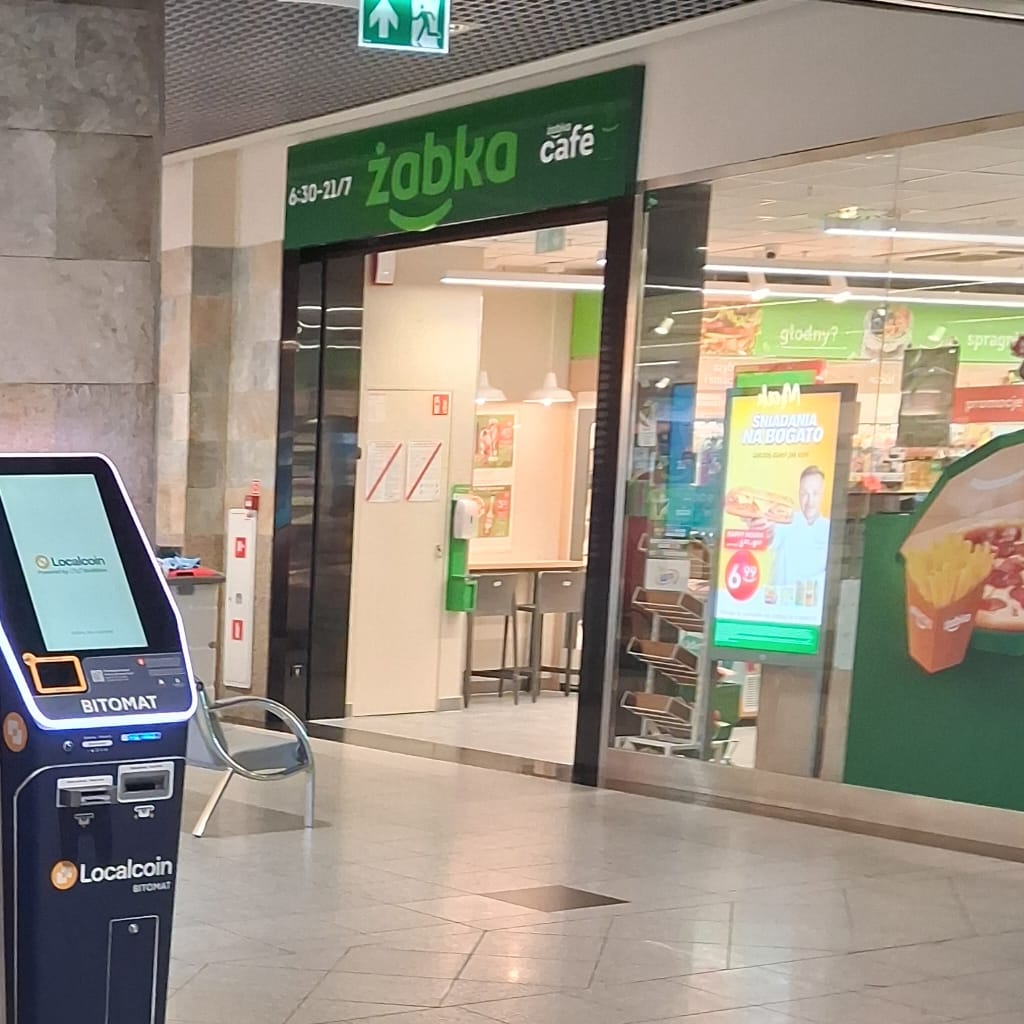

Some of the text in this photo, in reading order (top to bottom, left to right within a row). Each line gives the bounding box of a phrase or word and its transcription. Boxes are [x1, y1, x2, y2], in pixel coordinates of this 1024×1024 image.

[540, 124, 595, 163] café
[366, 124, 518, 207] żabka
[779, 324, 839, 346] głodny?
[764, 426, 824, 445] BOGATO
[50, 555, 106, 567] Localcoin
[727, 563, 742, 590] 6
[80, 695, 157, 714] BITOMAT
[80, 855, 173, 884] Localcoin
[132, 881, 172, 893] BITOMAT
